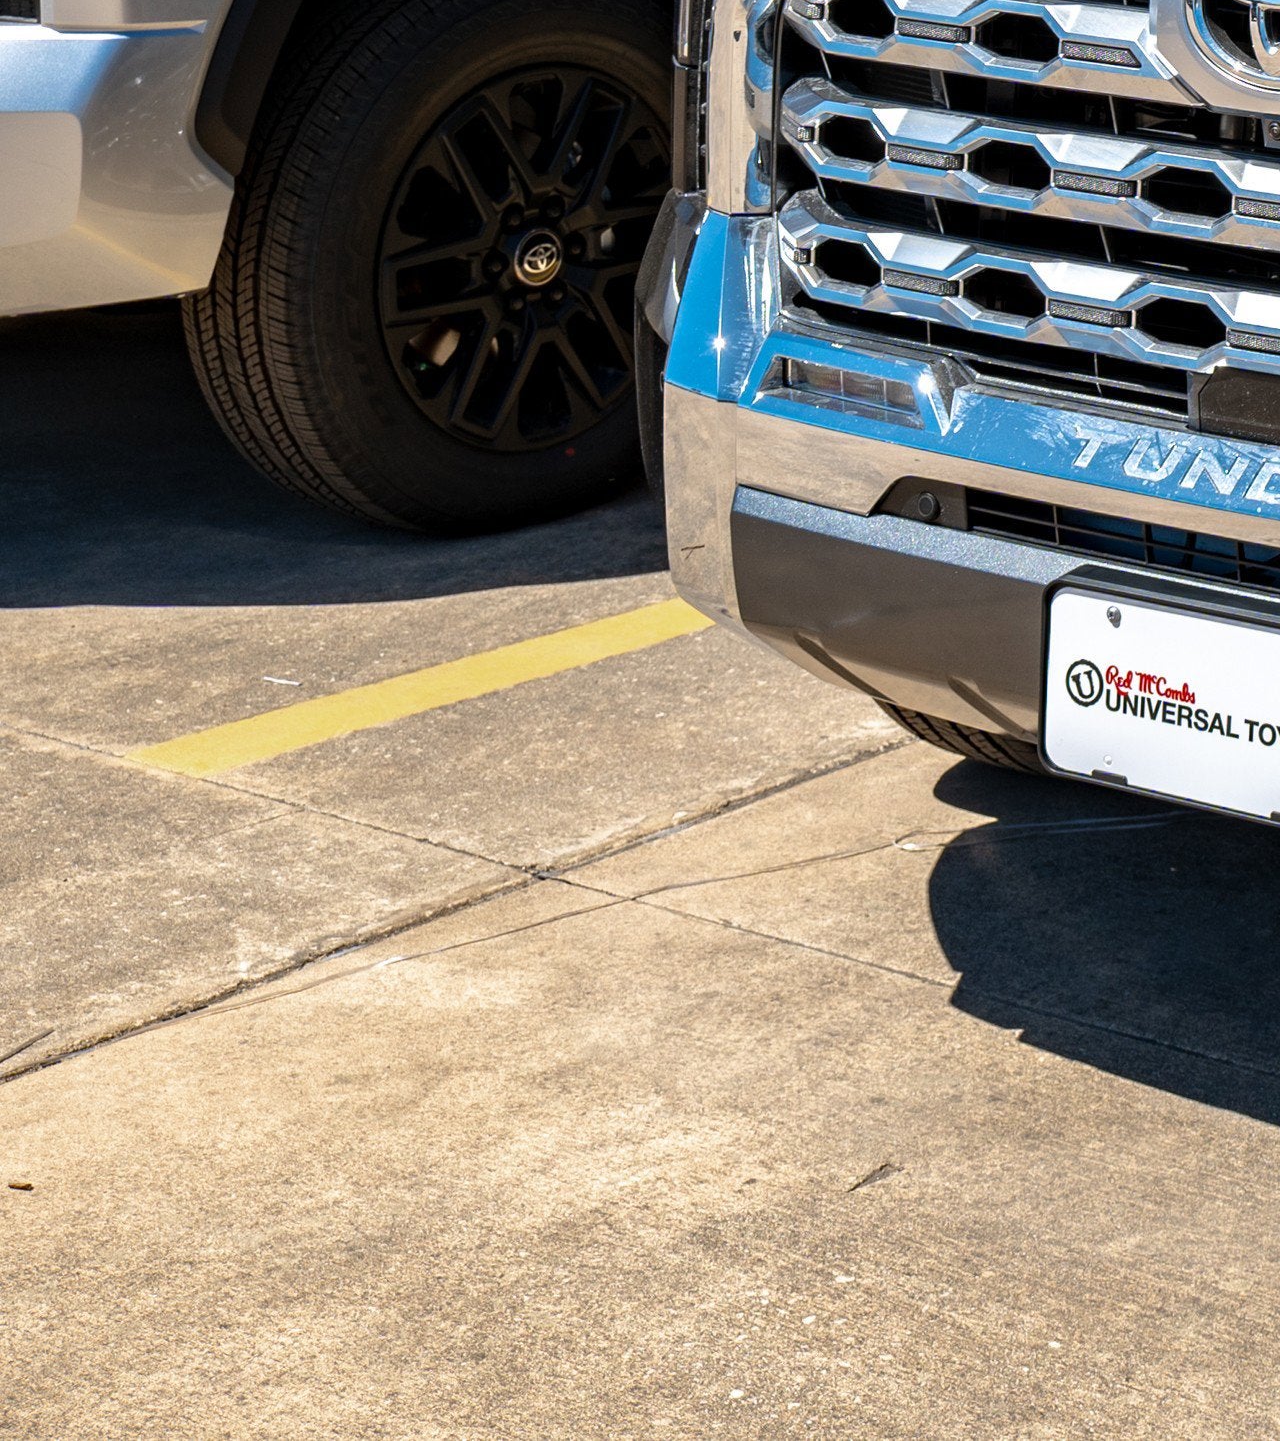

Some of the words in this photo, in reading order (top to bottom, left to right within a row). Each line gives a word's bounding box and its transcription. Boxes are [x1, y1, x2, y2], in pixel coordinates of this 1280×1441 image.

[1105, 665, 1132, 696] Red
[1135, 670, 1196, 704] McCombs
[1105, 688, 1240, 739] UNIVERSAL
